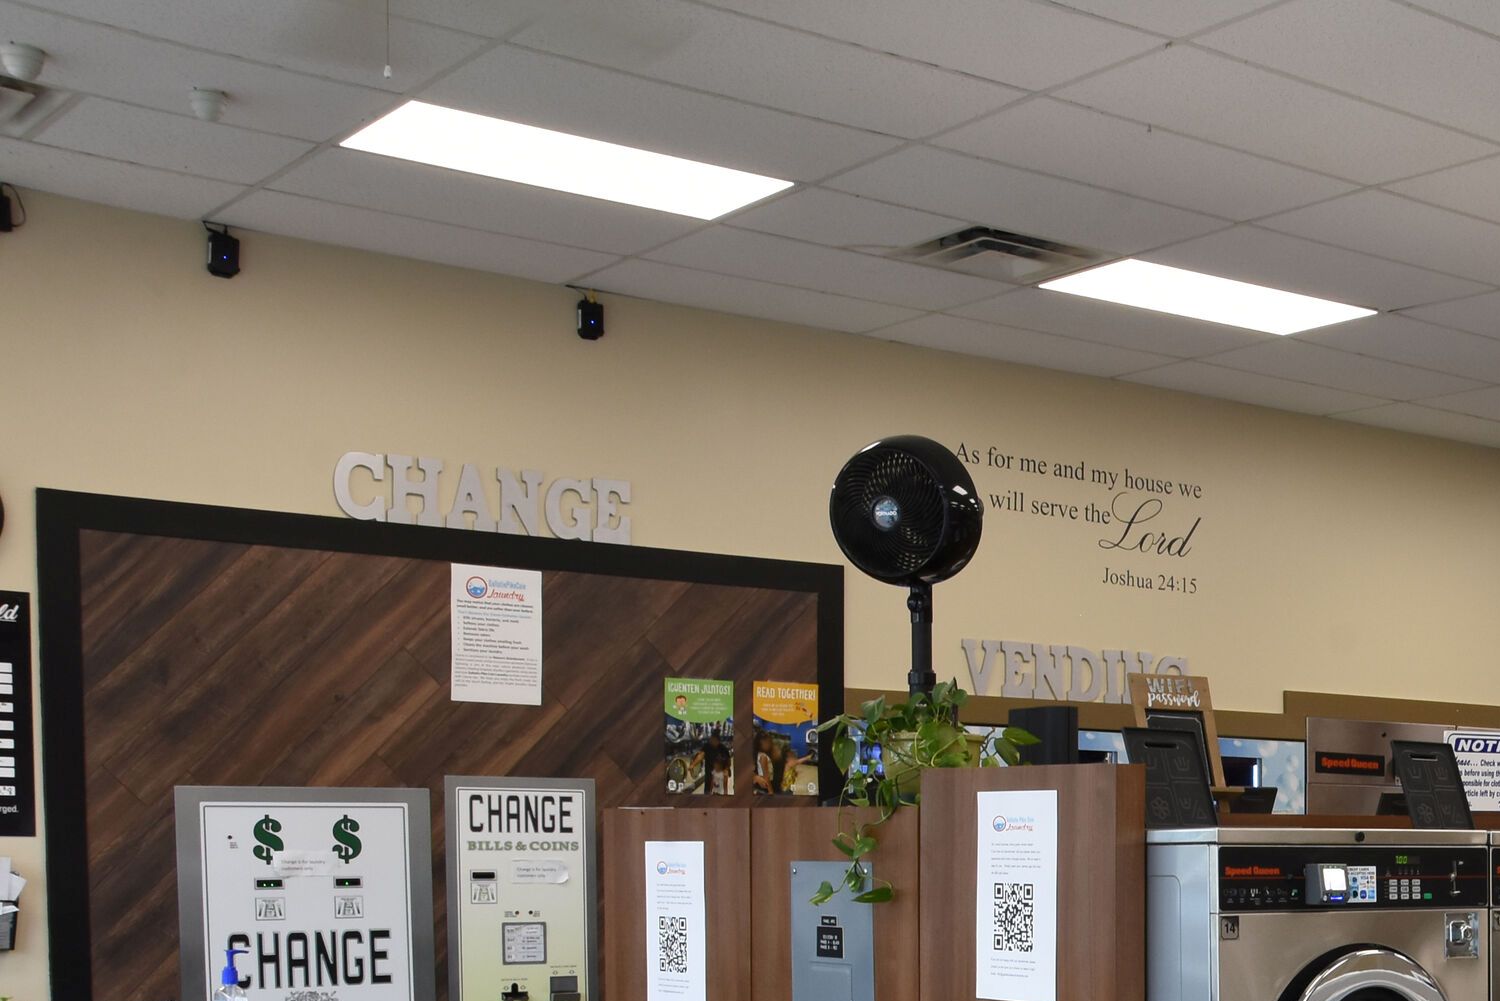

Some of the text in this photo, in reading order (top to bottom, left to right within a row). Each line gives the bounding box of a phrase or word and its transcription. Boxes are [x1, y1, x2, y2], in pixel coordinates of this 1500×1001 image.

[956, 442, 1202, 499] As for me and my house we
[333, 451, 632, 545] CHANGE
[989, 490, 1110, 524] will serve the
[1098, 492, 1201, 558] Lord
[1102, 567, 1197, 594] Joshua 24:15
[756, 686, 816, 701] READ TOGETHER!
[1147, 690, 1200, 707] password
[1321, 756, 1379, 769] Speed Queen
[1489, 790, 1495, 798] by
[469, 794, 573, 833] CHANGE
[467, 841, 579, 851] BILLS & COINS
[1225, 866, 1280, 876] Speed Queen
[1224, 923, 1236, 934] 14
[228, 930, 392, 989] CHANGE
